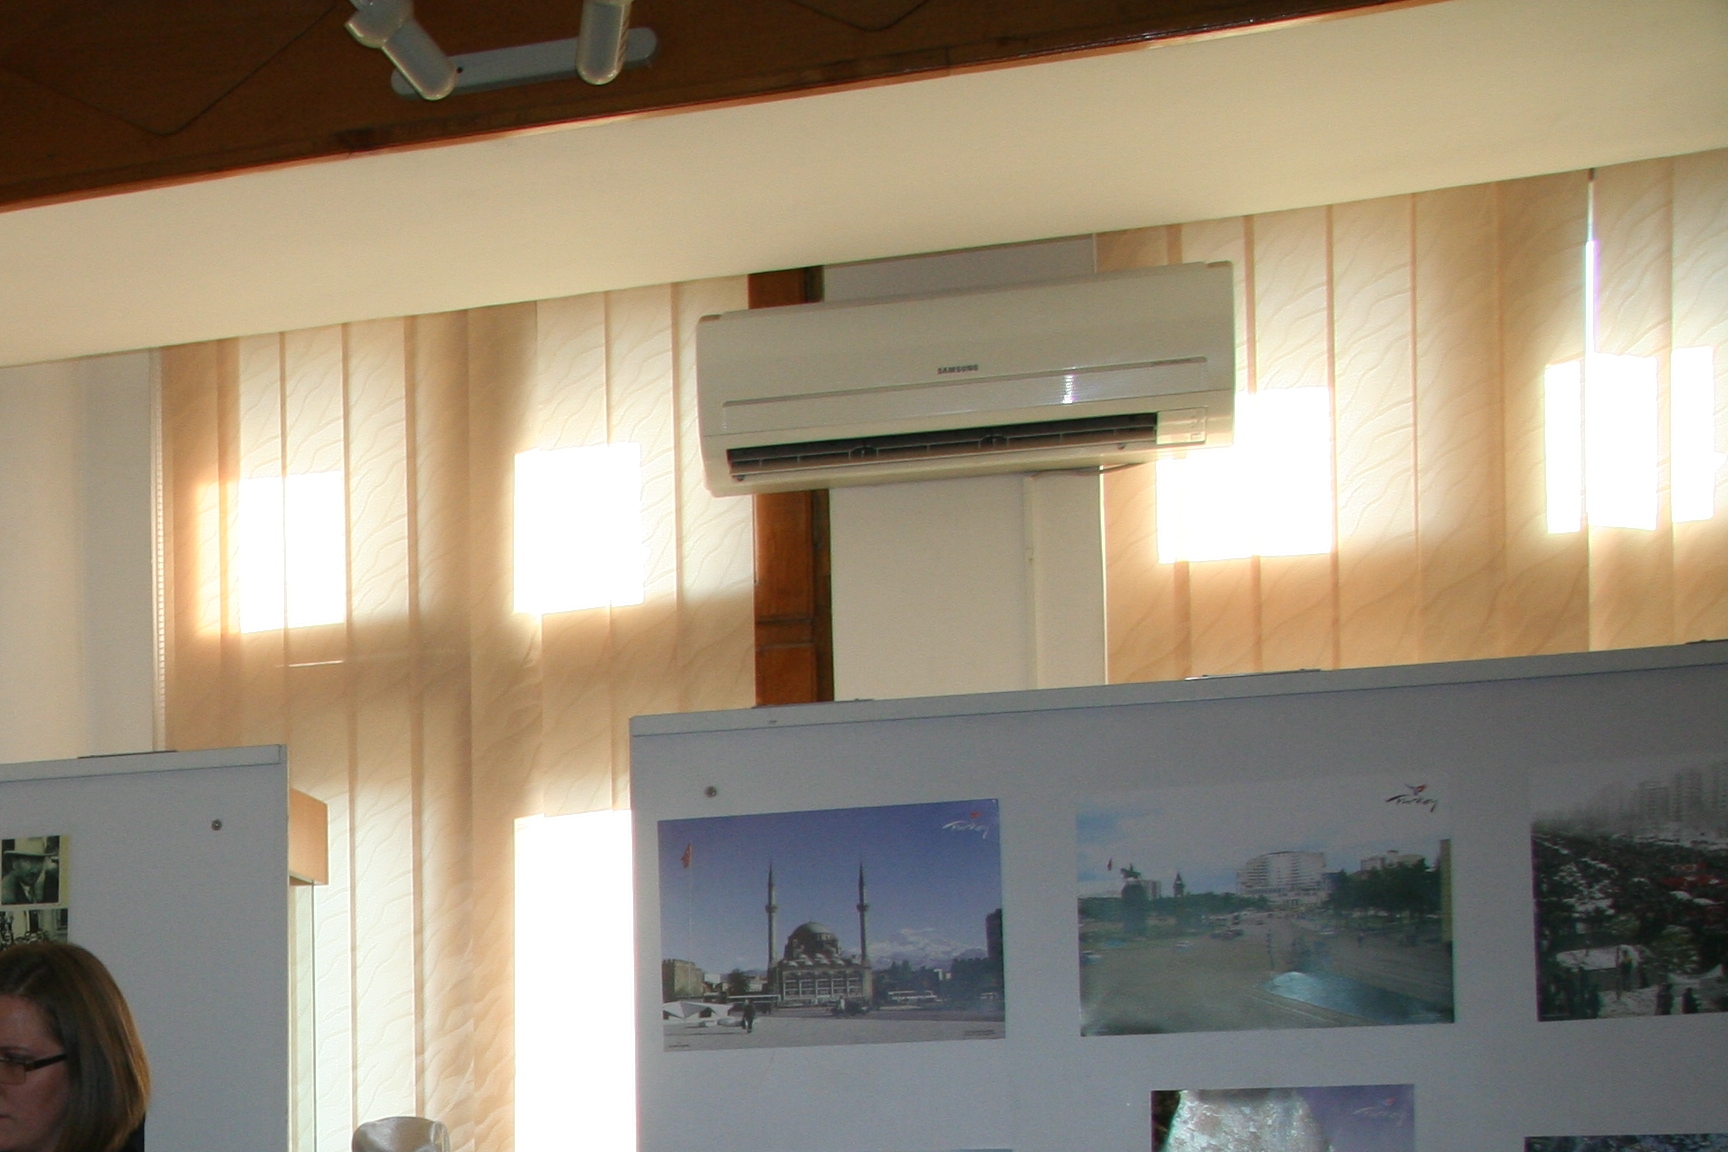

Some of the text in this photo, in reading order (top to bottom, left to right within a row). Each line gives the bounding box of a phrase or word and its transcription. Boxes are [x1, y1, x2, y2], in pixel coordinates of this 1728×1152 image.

[937, 364, 979, 374] SAMSUNG
[1385, 794, 1439, 813] Turkey
[942, 820, 989, 839] Turkey
